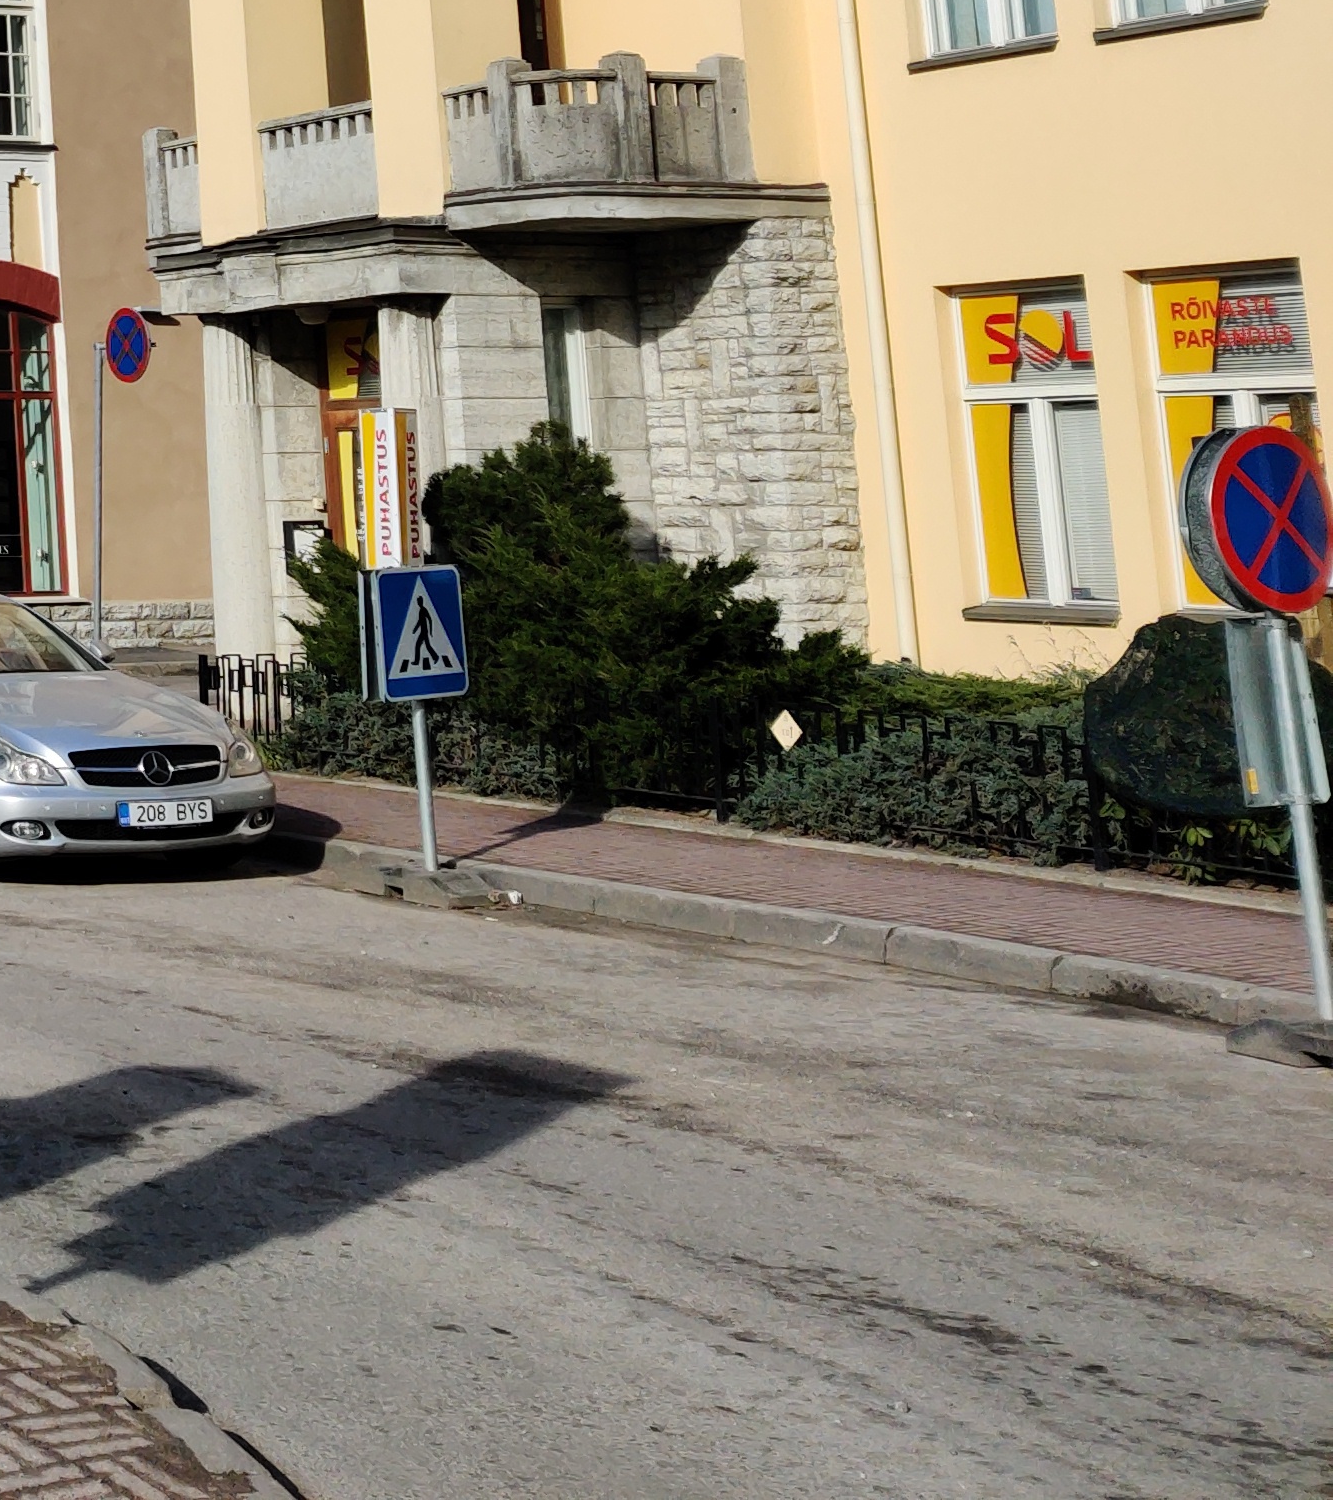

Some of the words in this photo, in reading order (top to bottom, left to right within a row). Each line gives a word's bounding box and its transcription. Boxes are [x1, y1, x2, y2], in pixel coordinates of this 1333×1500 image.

[1170, 295, 1278, 321] RÕIVASTE
[1173, 323, 1293, 350] PARANDUS
[375, 428, 393, 557] PUHASTUS
[406, 430, 421, 560] PUHASTUS
[136, 805, 166, 823] 208
[176, 801, 208, 821] BYS
